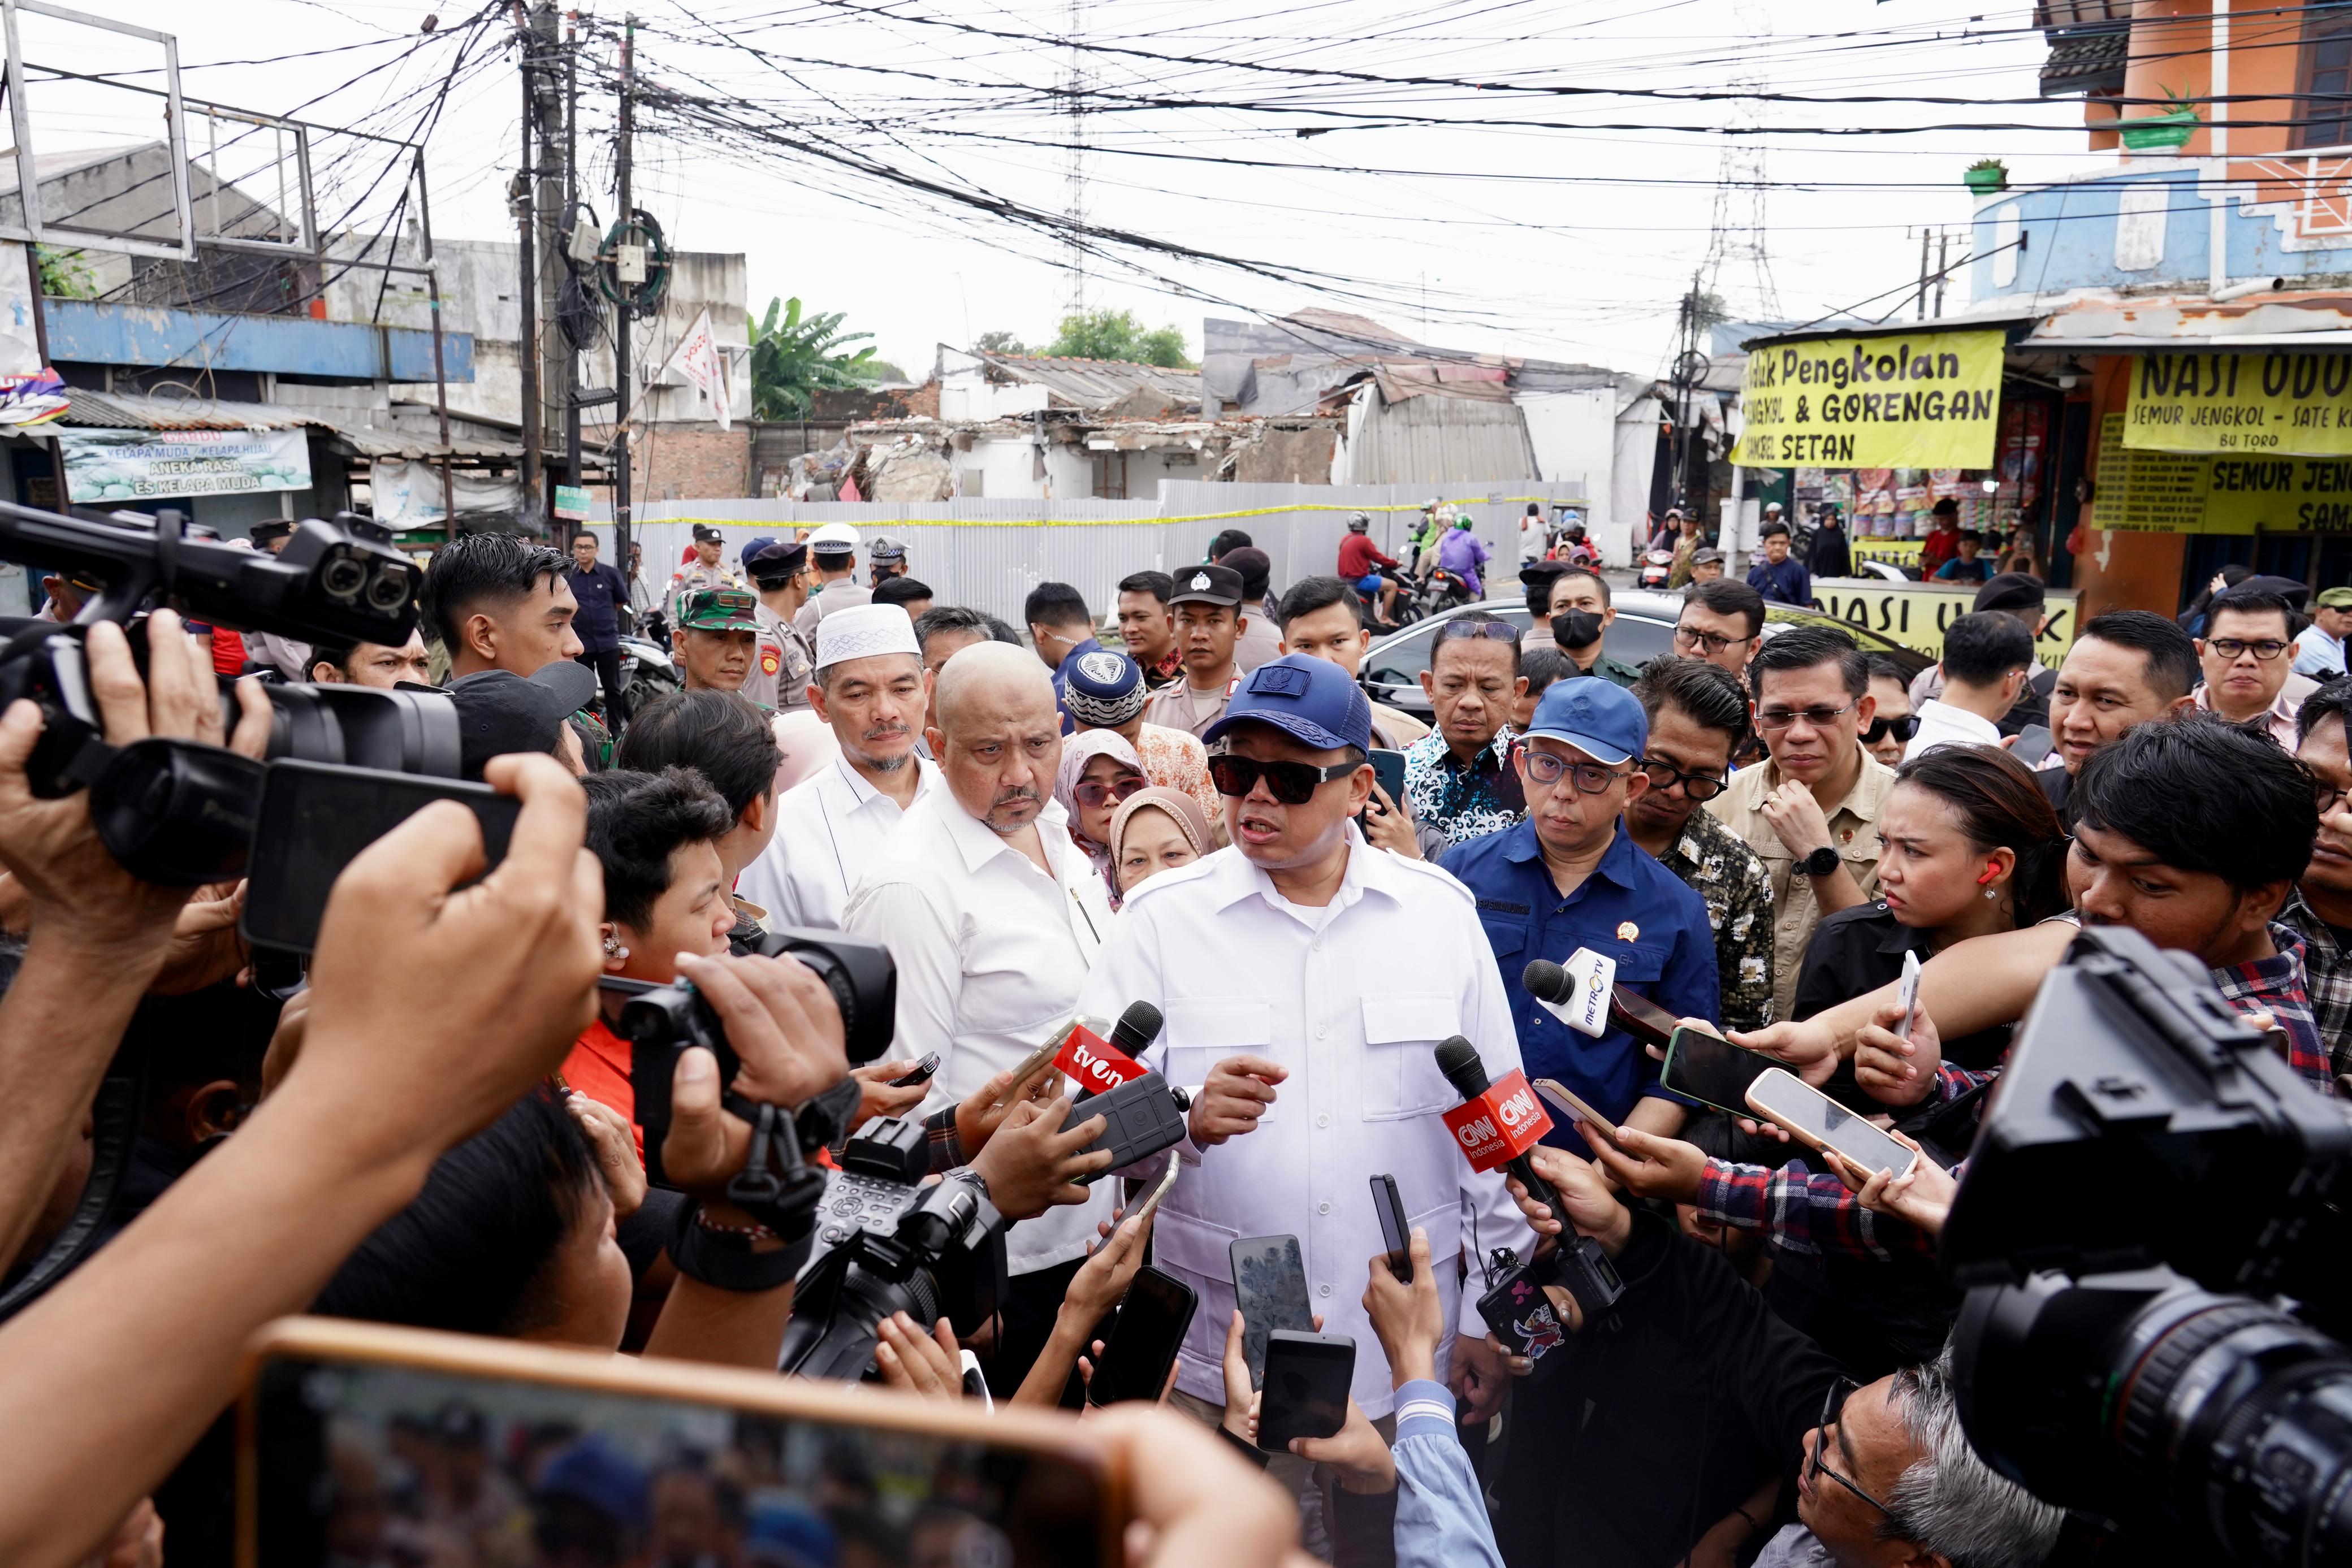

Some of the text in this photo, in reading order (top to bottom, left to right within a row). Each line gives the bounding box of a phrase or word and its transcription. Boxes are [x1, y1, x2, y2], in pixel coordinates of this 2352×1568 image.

[1783, 344, 1958, 389] Pengkolan
[2140, 354, 2239, 400] NASI
[1795, 395, 1810, 423] &
[1822, 389, 1993, 423] GORENGAN
[2132, 404, 2184, 425] SEMUR
[2190, 406, 2264, 426] JENGKOL
[2292, 405, 2331, 428] SATE
[155, 447, 189, 458] MUDA
[202, 445, 239, 456] KELAPA
[162, 431, 222, 444] GARDU
[1782, 434, 1855, 461] SETAN
[2220, 434, 2278, 447] BU TORO
[150, 460, 243, 475] ANEKA RASA
[2213, 461, 2352, 492] SEMUR JEN
[135, 477, 261, 495] ES KELAPA MUDA
[2298, 501, 2352, 530] SAM
[1499, 1088, 1534, 1126] CNN
[1458, 1115, 1498, 1147] CNN
[1510, 1111, 1542, 1140] Indonesia
[1468, 1139, 1506, 1159] Indonesia
